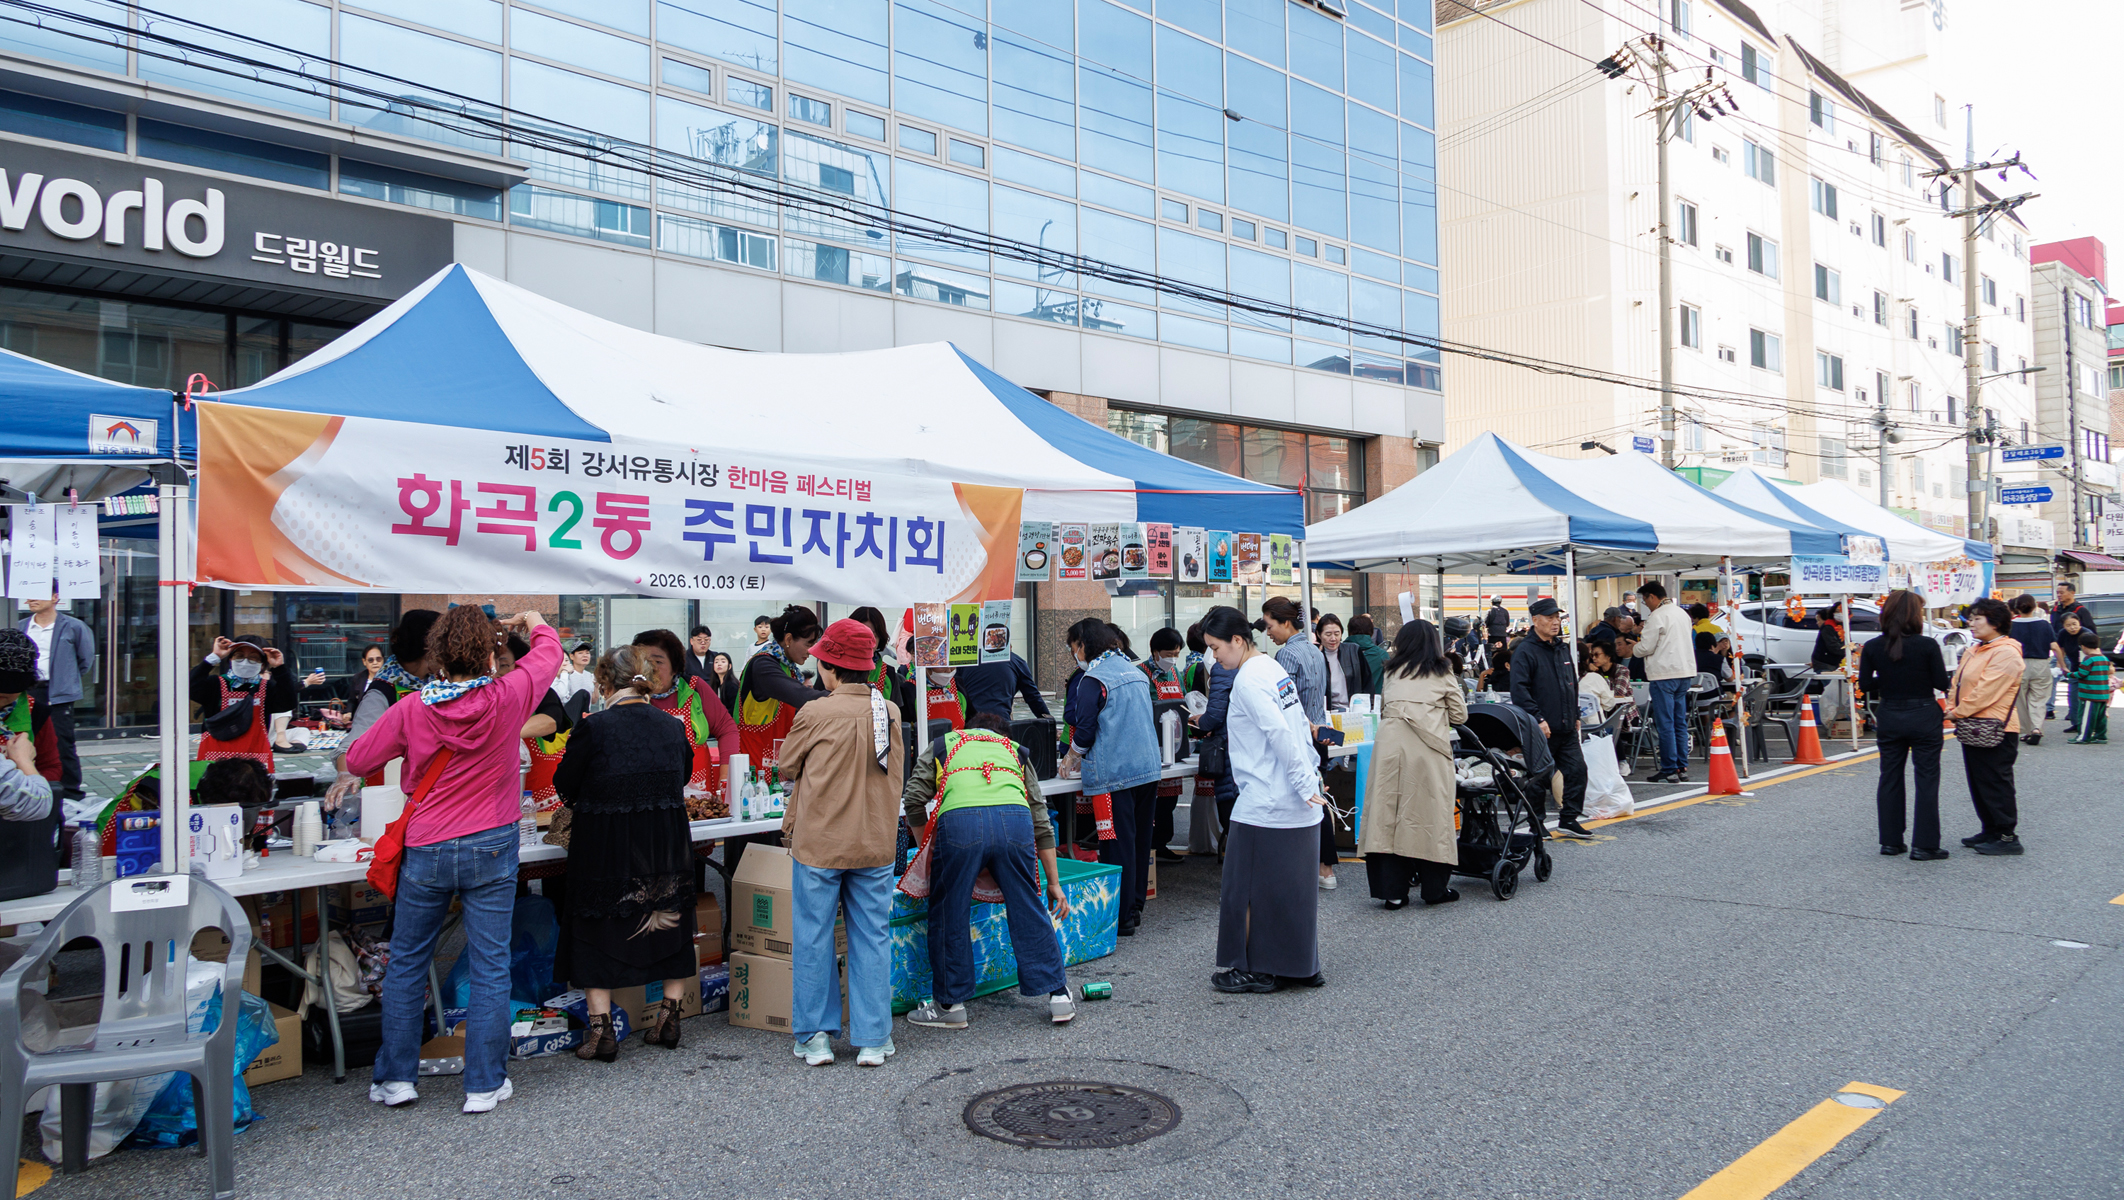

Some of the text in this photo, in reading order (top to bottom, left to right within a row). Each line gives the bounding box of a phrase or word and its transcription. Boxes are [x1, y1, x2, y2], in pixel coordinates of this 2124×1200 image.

[250, 230, 383, 279] 드림월드
[504, 444, 873, 503] 제5회 강서유통시장 한마음 페스티벌
[391, 472, 946, 575] 화곡2동 주민자치회
[1240, 542, 1259, 552] 번데기
[649, 572, 766, 591] 2026.10.03 (토)
[1802, 564, 1880, 583] 화곡8동 한국자유총연맹
[917, 613, 942, 626] 번데기
[950, 645, 977, 655] 순대 5천원
[734, 962, 749, 1010] 평생
